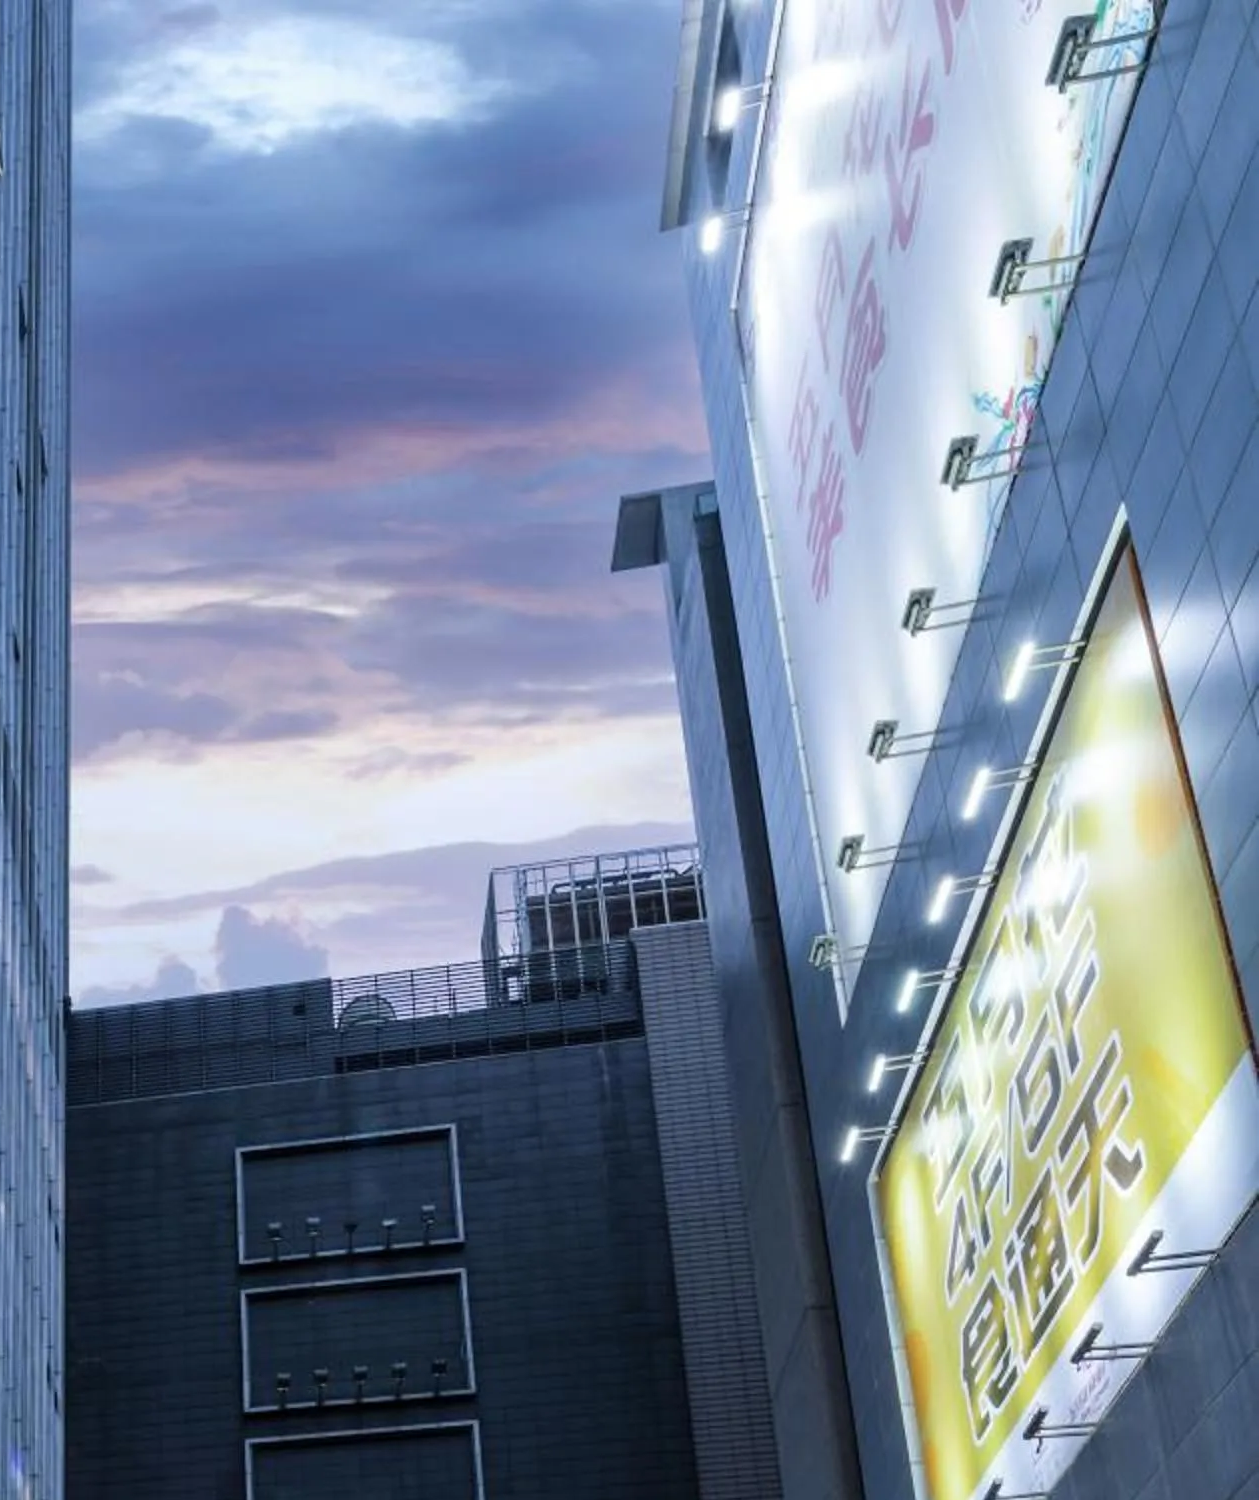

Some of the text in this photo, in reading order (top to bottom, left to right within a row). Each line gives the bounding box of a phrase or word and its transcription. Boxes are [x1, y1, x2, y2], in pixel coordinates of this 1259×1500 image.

[922, 764, 1089, 1214] 五月花
[947, 907, 1100, 1308] 4F/5F
[961, 1029, 1144, 1446] 食通天
